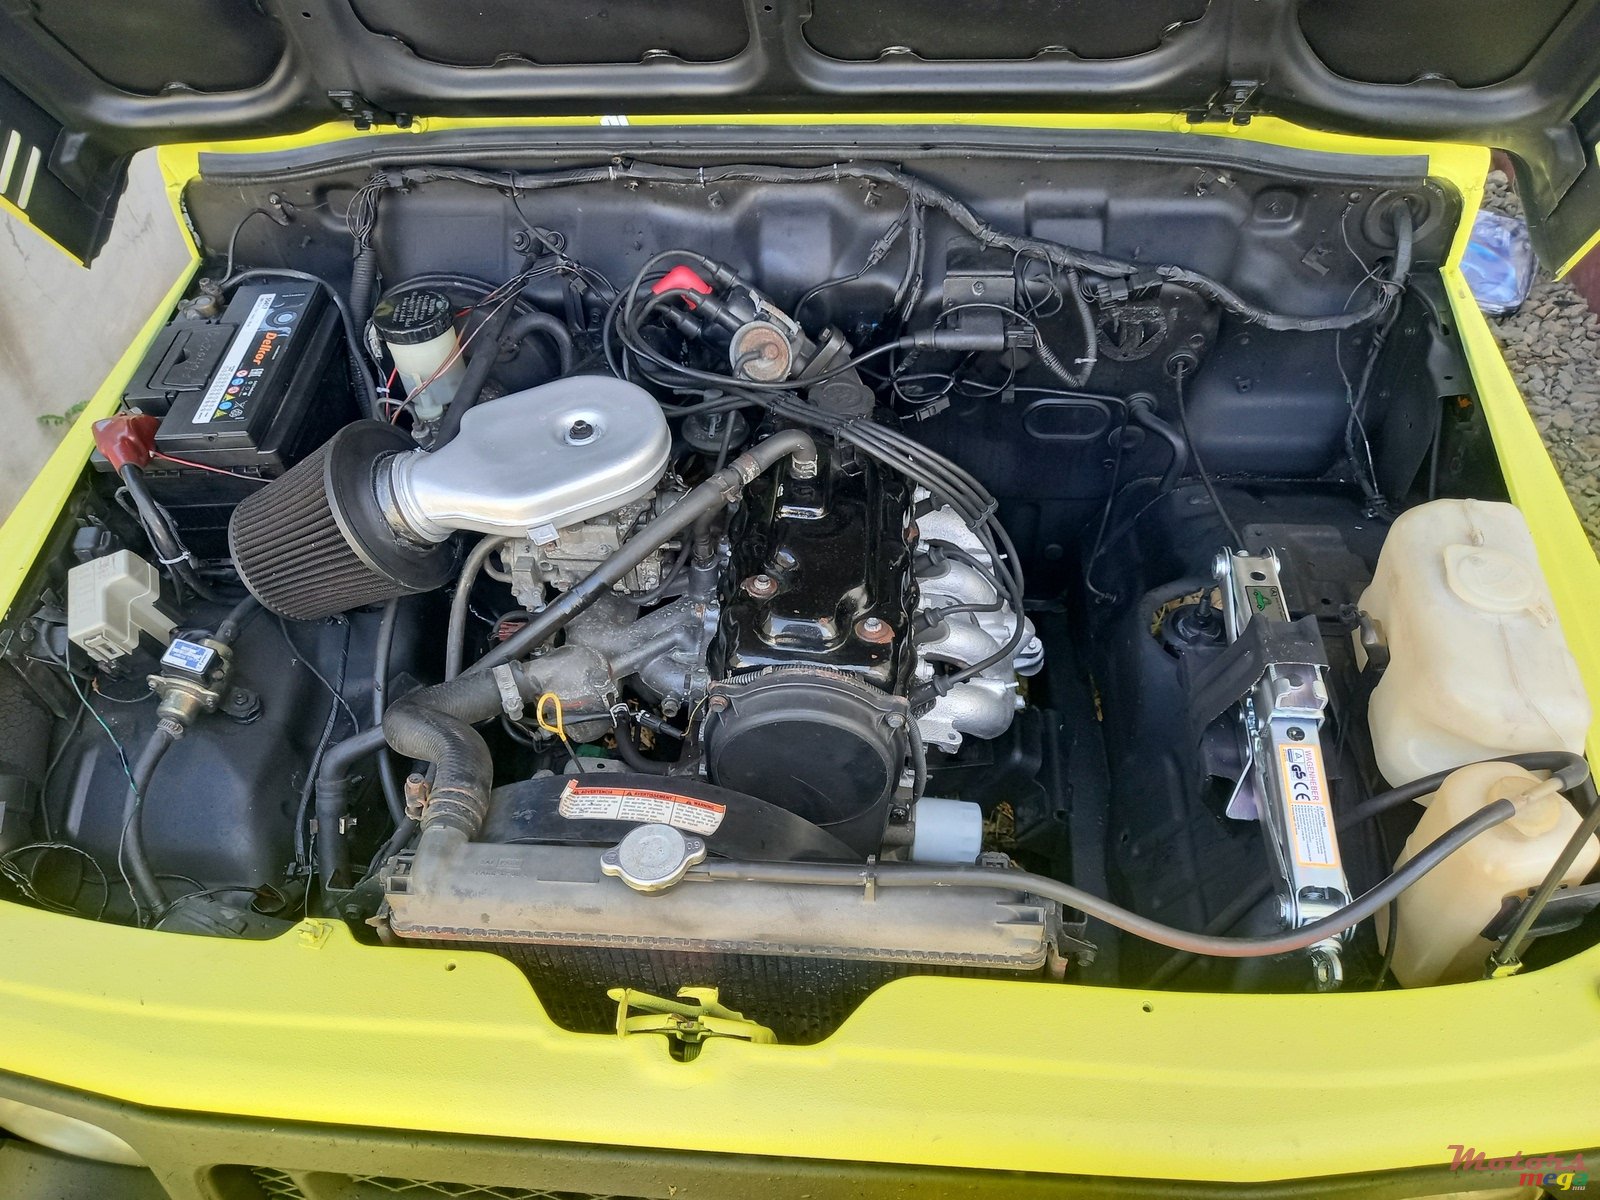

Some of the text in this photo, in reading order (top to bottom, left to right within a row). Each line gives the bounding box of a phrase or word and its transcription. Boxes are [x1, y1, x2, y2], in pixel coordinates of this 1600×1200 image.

[253, 332, 277, 365] Delkor
[1291, 764, 1306, 779] GS
[1305, 750, 1319, 801] WAGENHEBER
[634, 791, 673, 800] AVERTISSEMENT
[1294, 782, 1311, 801] CE
[694, 801, 714, 810] WARNING
